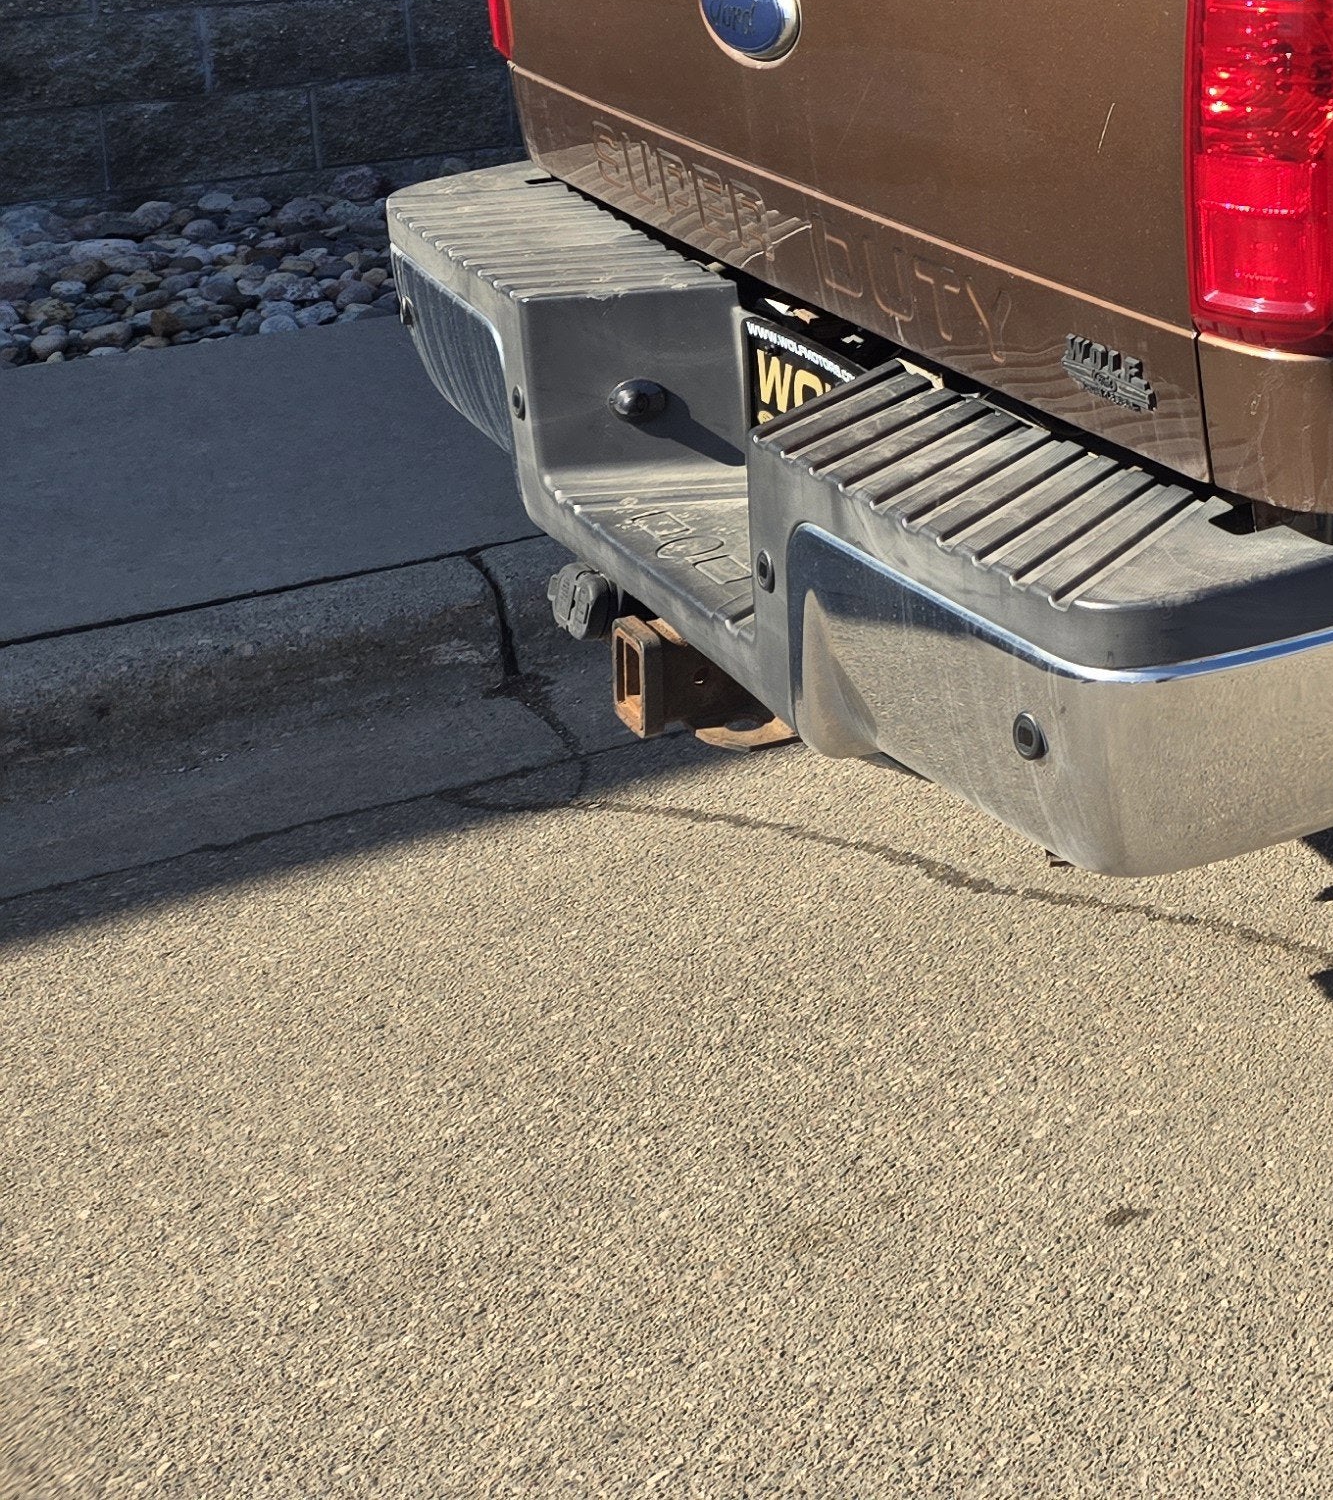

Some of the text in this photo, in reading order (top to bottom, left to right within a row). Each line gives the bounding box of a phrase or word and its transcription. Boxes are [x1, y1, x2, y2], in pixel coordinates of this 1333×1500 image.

[592, 120, 1013, 364] SUPER DUTY
[756, 348, 832, 414] WO
